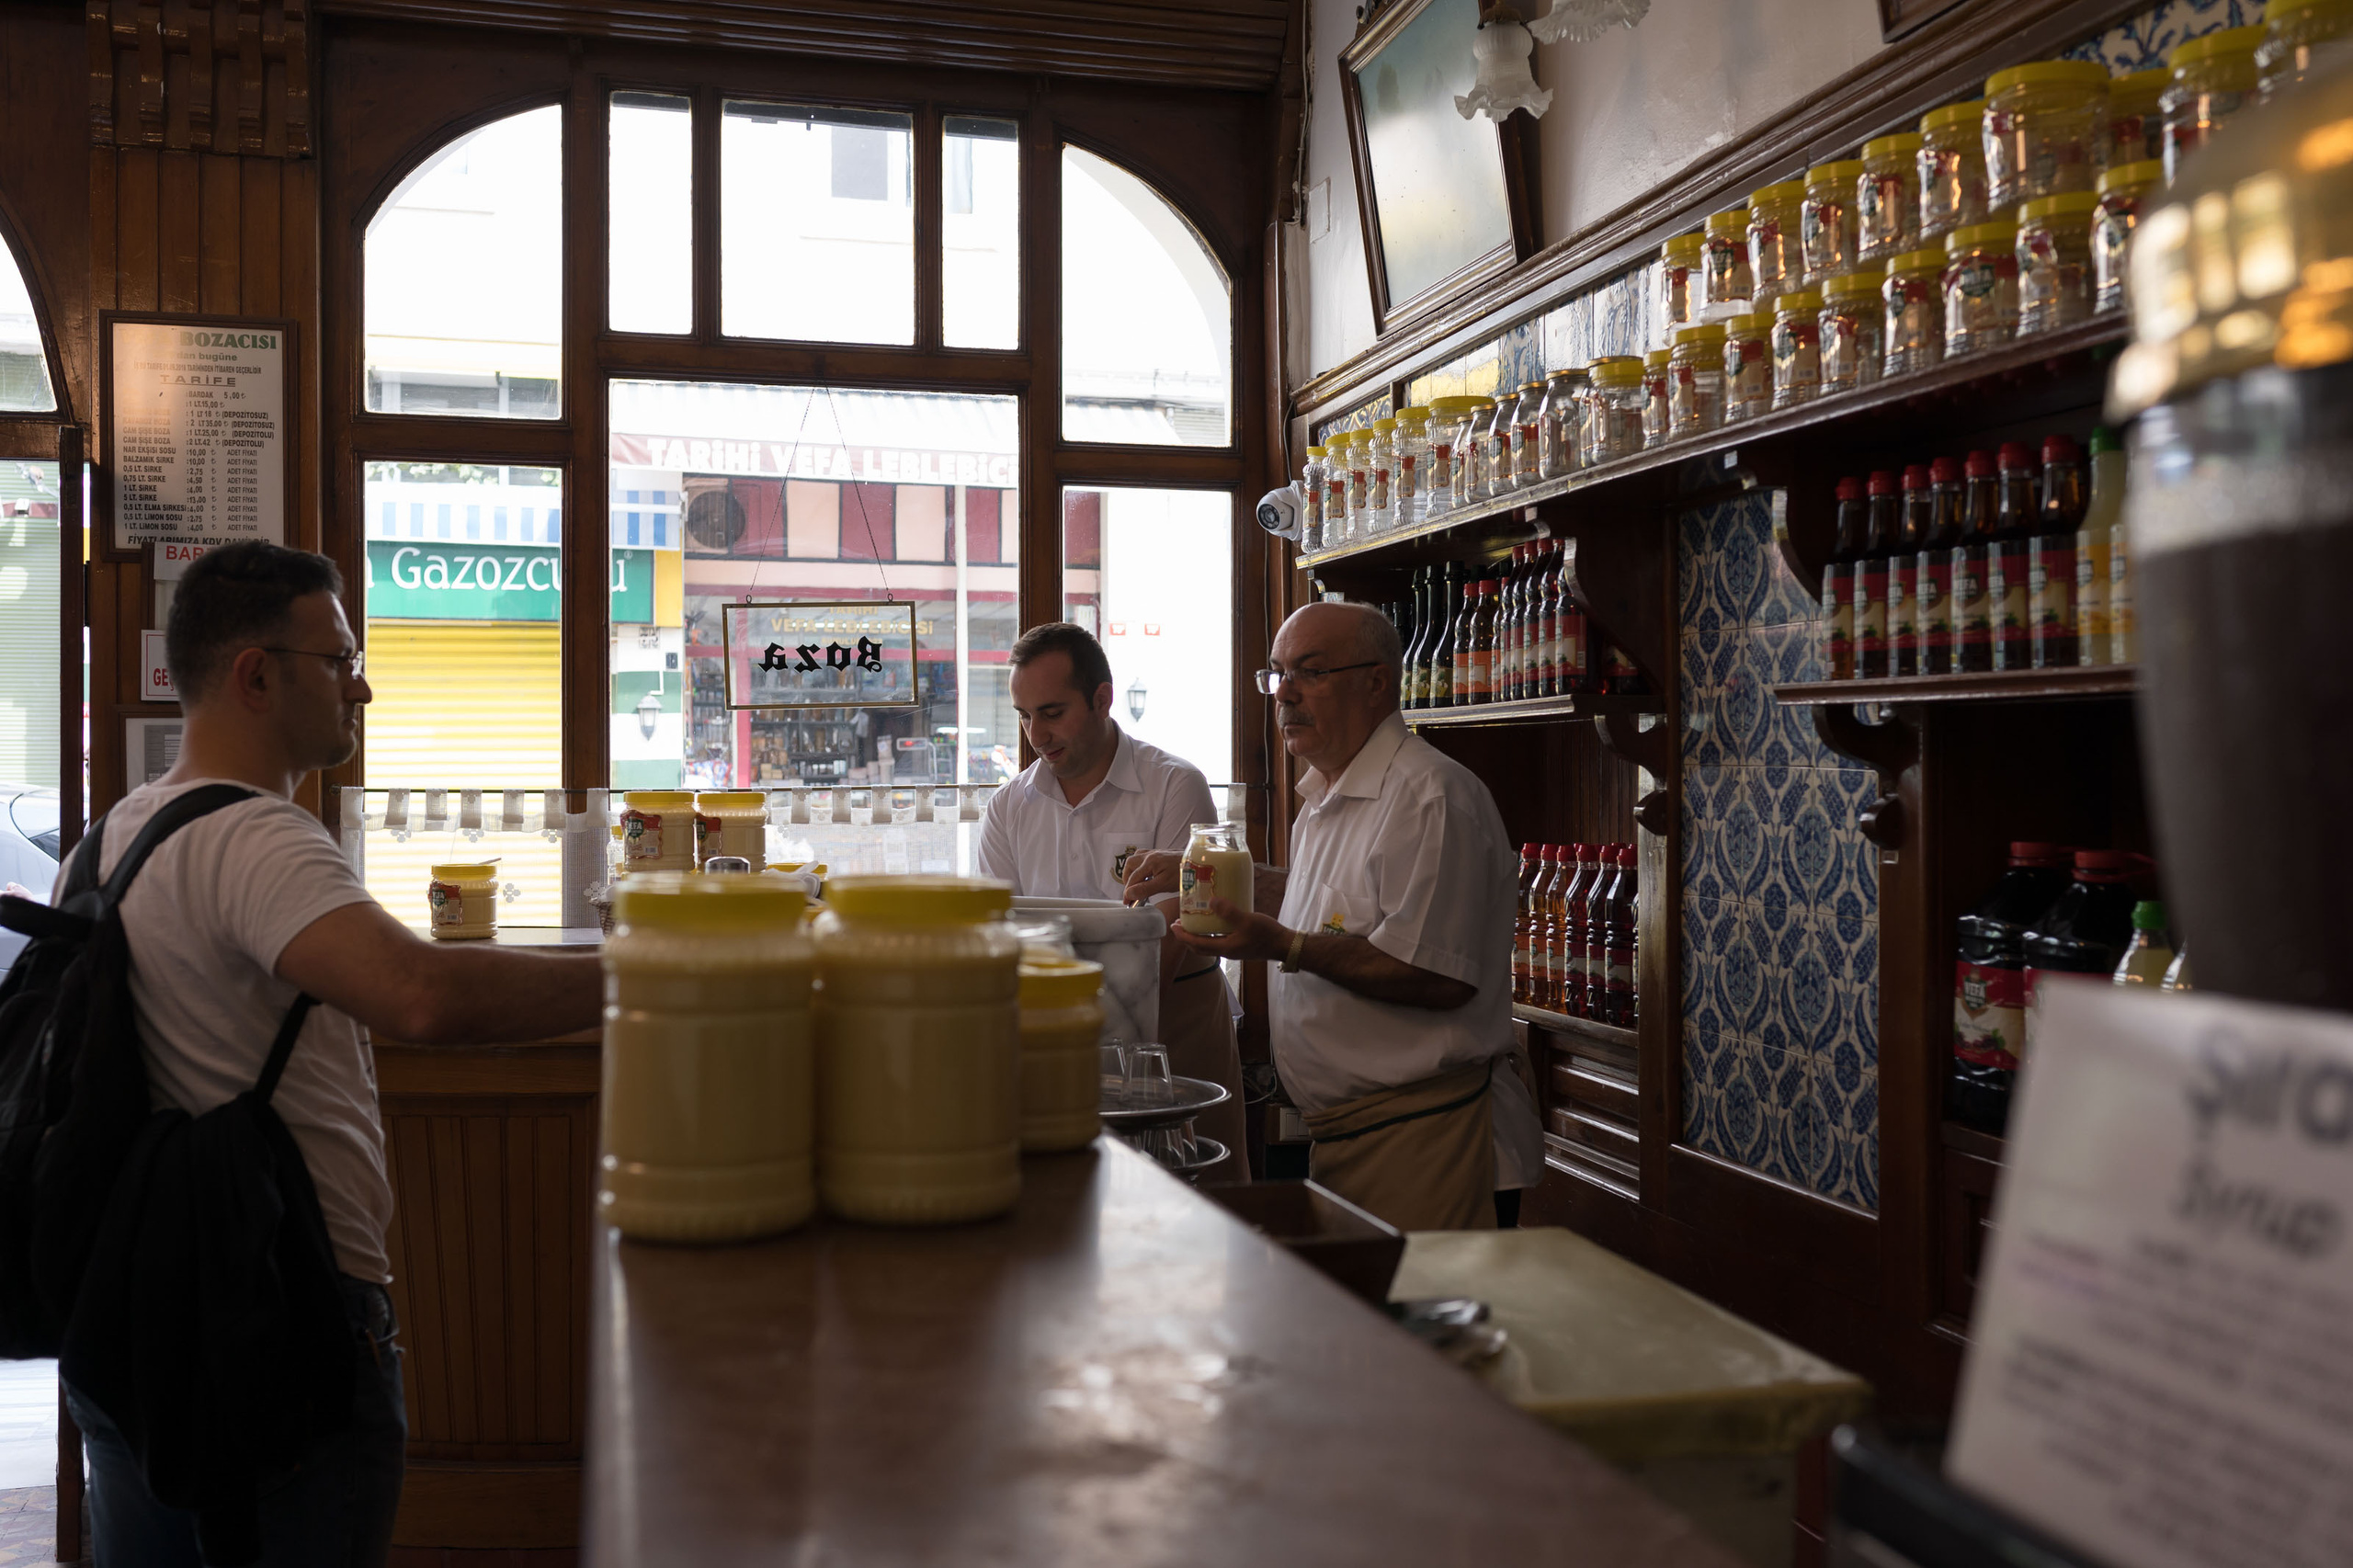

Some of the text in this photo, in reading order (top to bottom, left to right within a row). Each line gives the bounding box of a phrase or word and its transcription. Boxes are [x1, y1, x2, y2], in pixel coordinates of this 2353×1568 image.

[181, 332, 278, 350] BOZACISI
[199, 352, 237, 363] bugüne
[160, 374, 236, 386] TARİFE
[153, 437, 171, 445] BOZA
[165, 513, 183, 521] SOSU
[202, 537, 222, 546] KDV
[770, 618, 817, 633] VEFA
